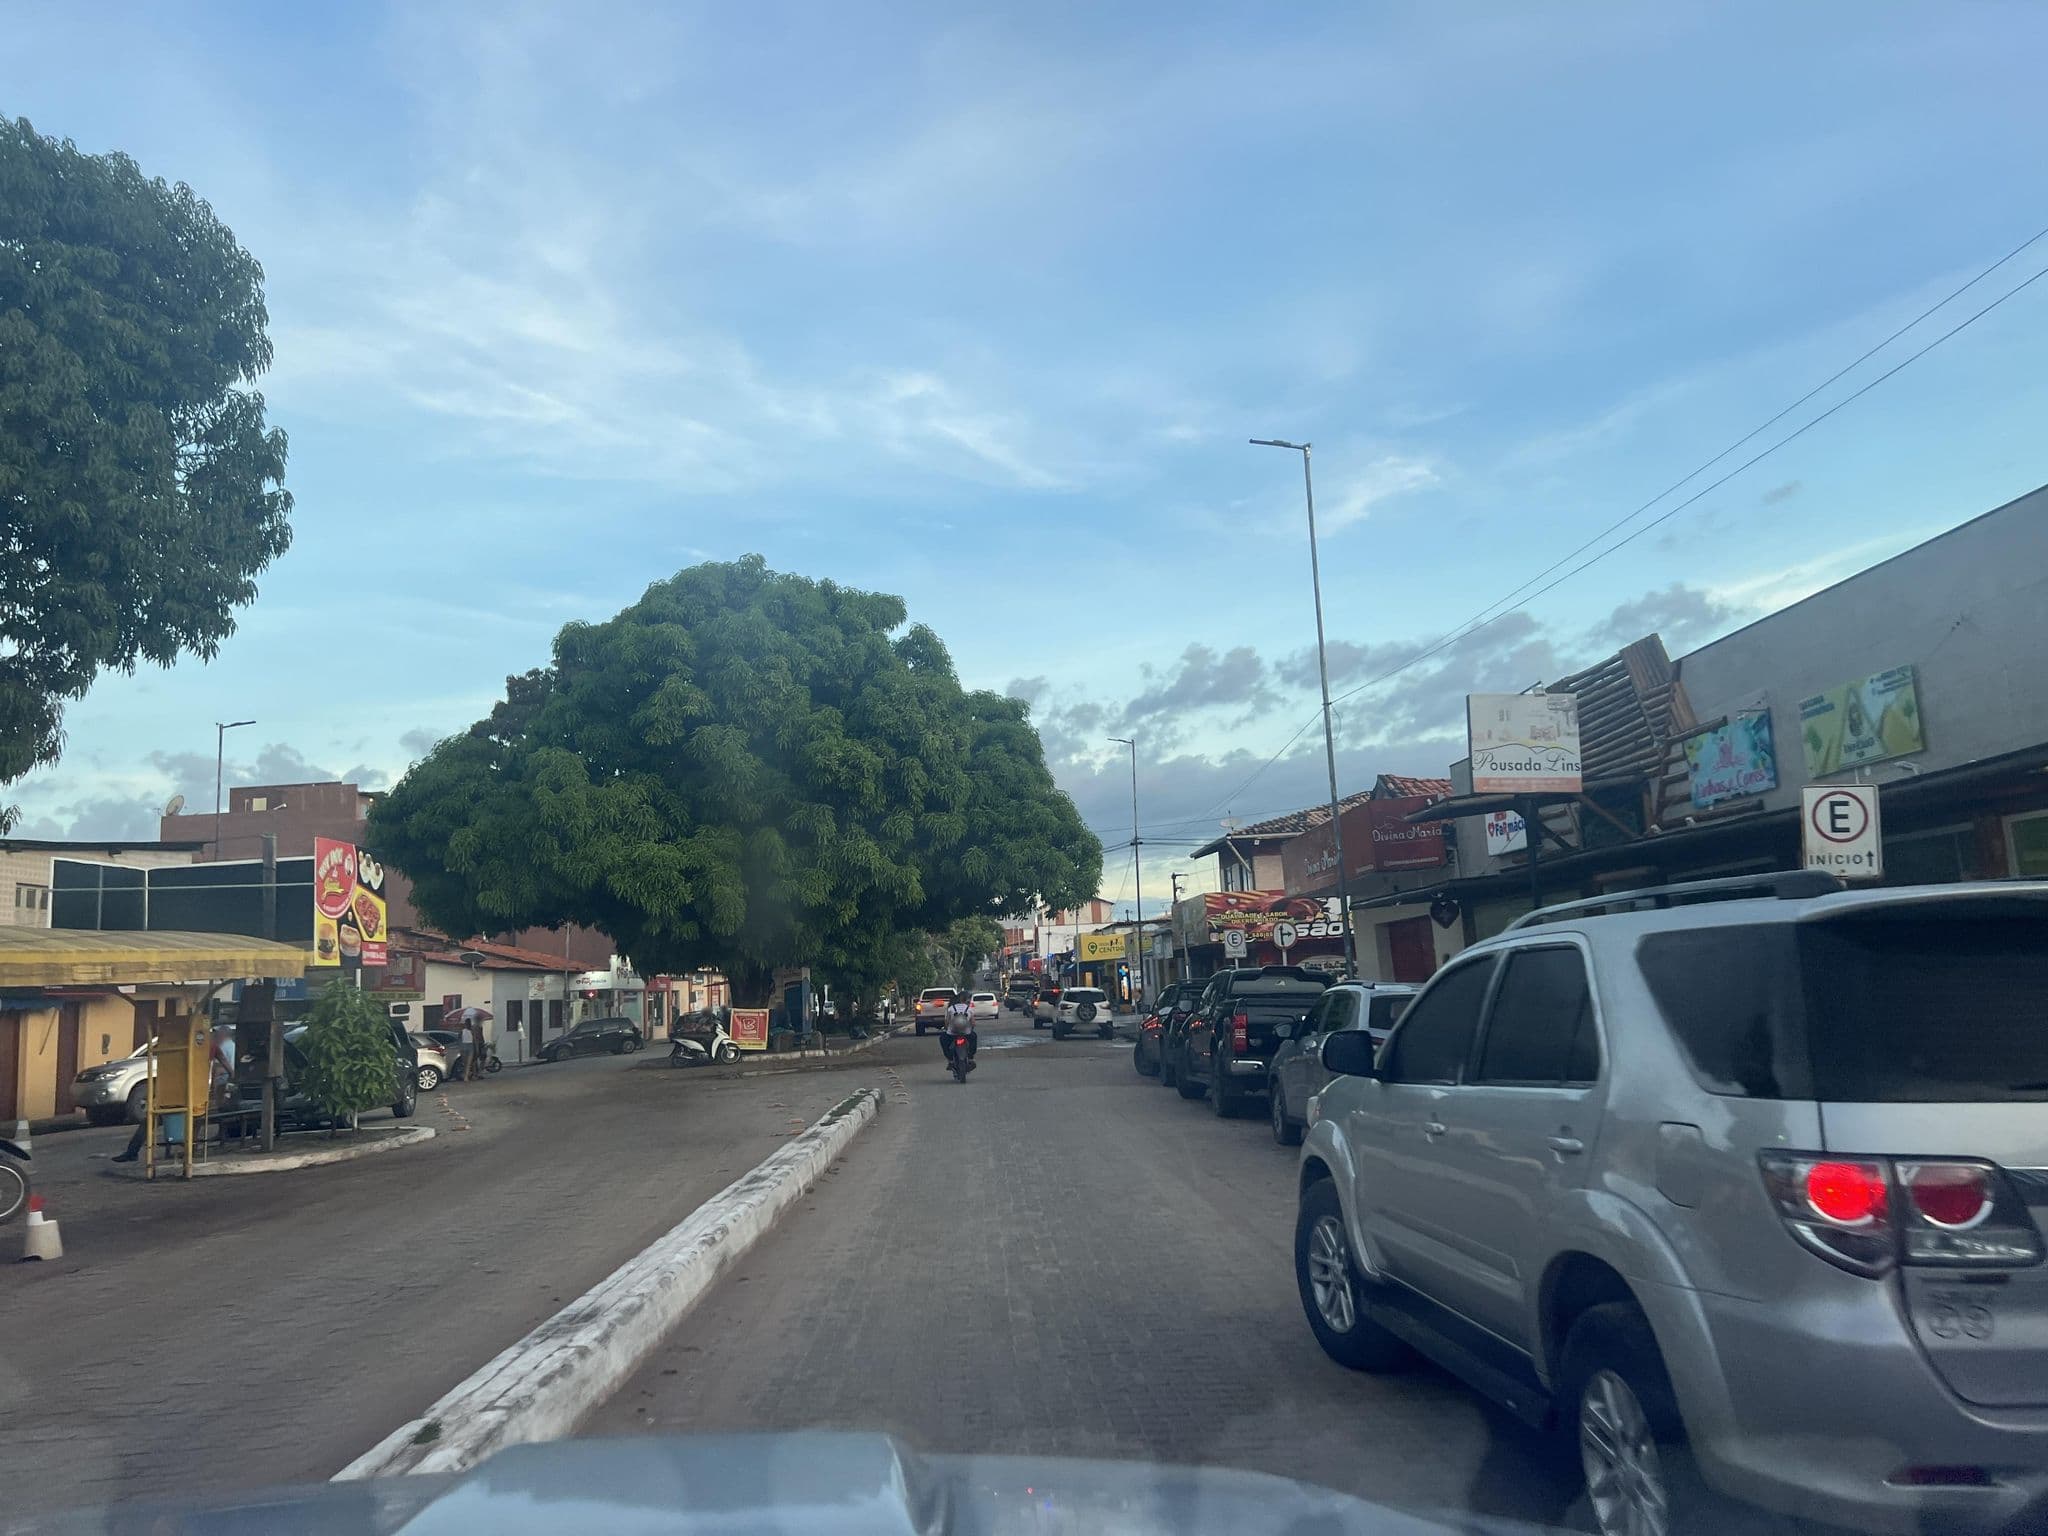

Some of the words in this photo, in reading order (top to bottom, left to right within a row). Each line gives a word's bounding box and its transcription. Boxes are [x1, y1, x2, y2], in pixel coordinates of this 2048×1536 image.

[1473, 751, 1542, 771] Pousada
[1543, 752, 1581, 771] Lins
[1829, 800, 1850, 833] E
[1372, 829, 1405, 842] Divina
[1406, 825, 1442, 840] Maria
[1809, 850, 1865, 865] INÍCIO
[1231, 934, 1238, 944] E
